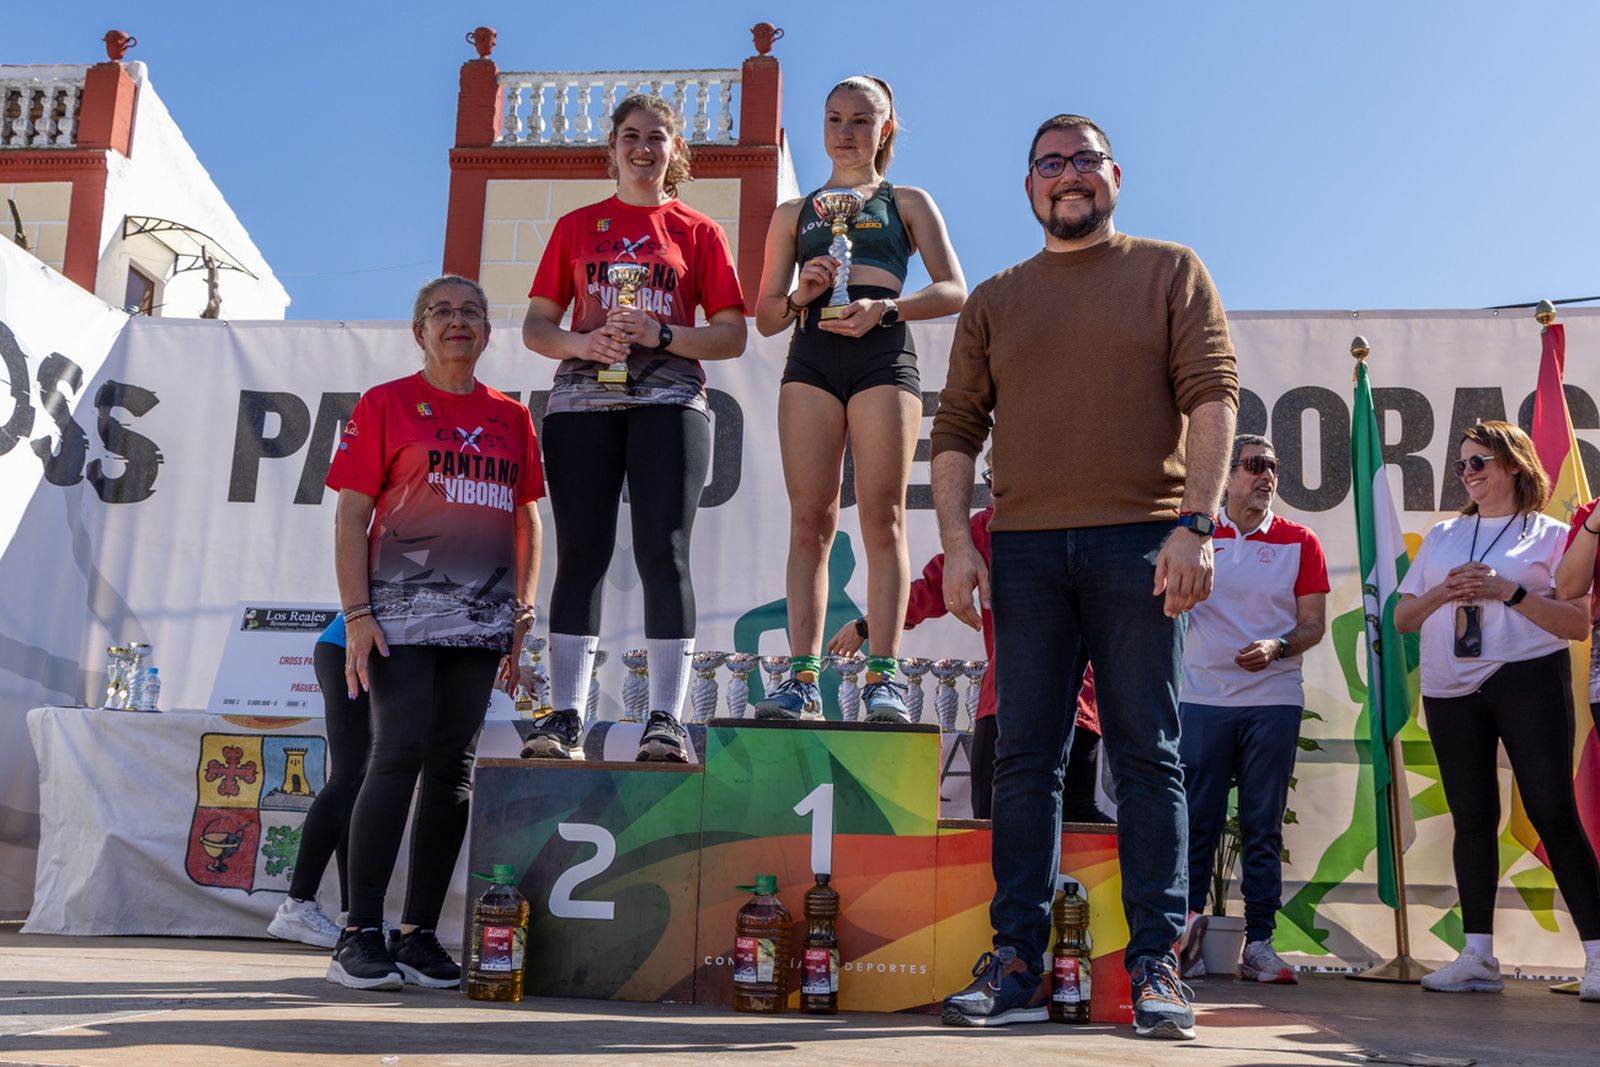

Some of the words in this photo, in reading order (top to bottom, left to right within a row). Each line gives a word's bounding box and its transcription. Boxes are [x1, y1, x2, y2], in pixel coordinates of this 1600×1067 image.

[586, 261, 676, 291] PANO
[436, 428, 508, 450] CROSS
[428, 450, 520, 488] PANTANO
[428, 472, 445, 484] DEL
[445, 473, 514, 513] VÍBORAS
[266, 610, 287, 621] Los
[290, 611, 326, 622] Reales
[279, 656, 303, 665] CROSS
[303, 656, 315, 666] PA
[290, 682, 322, 692] PÁGUES
[793, 784, 833, 875] 1
[548, 822, 616, 920] 2
[844, 961, 926, 973] DEPORTES
